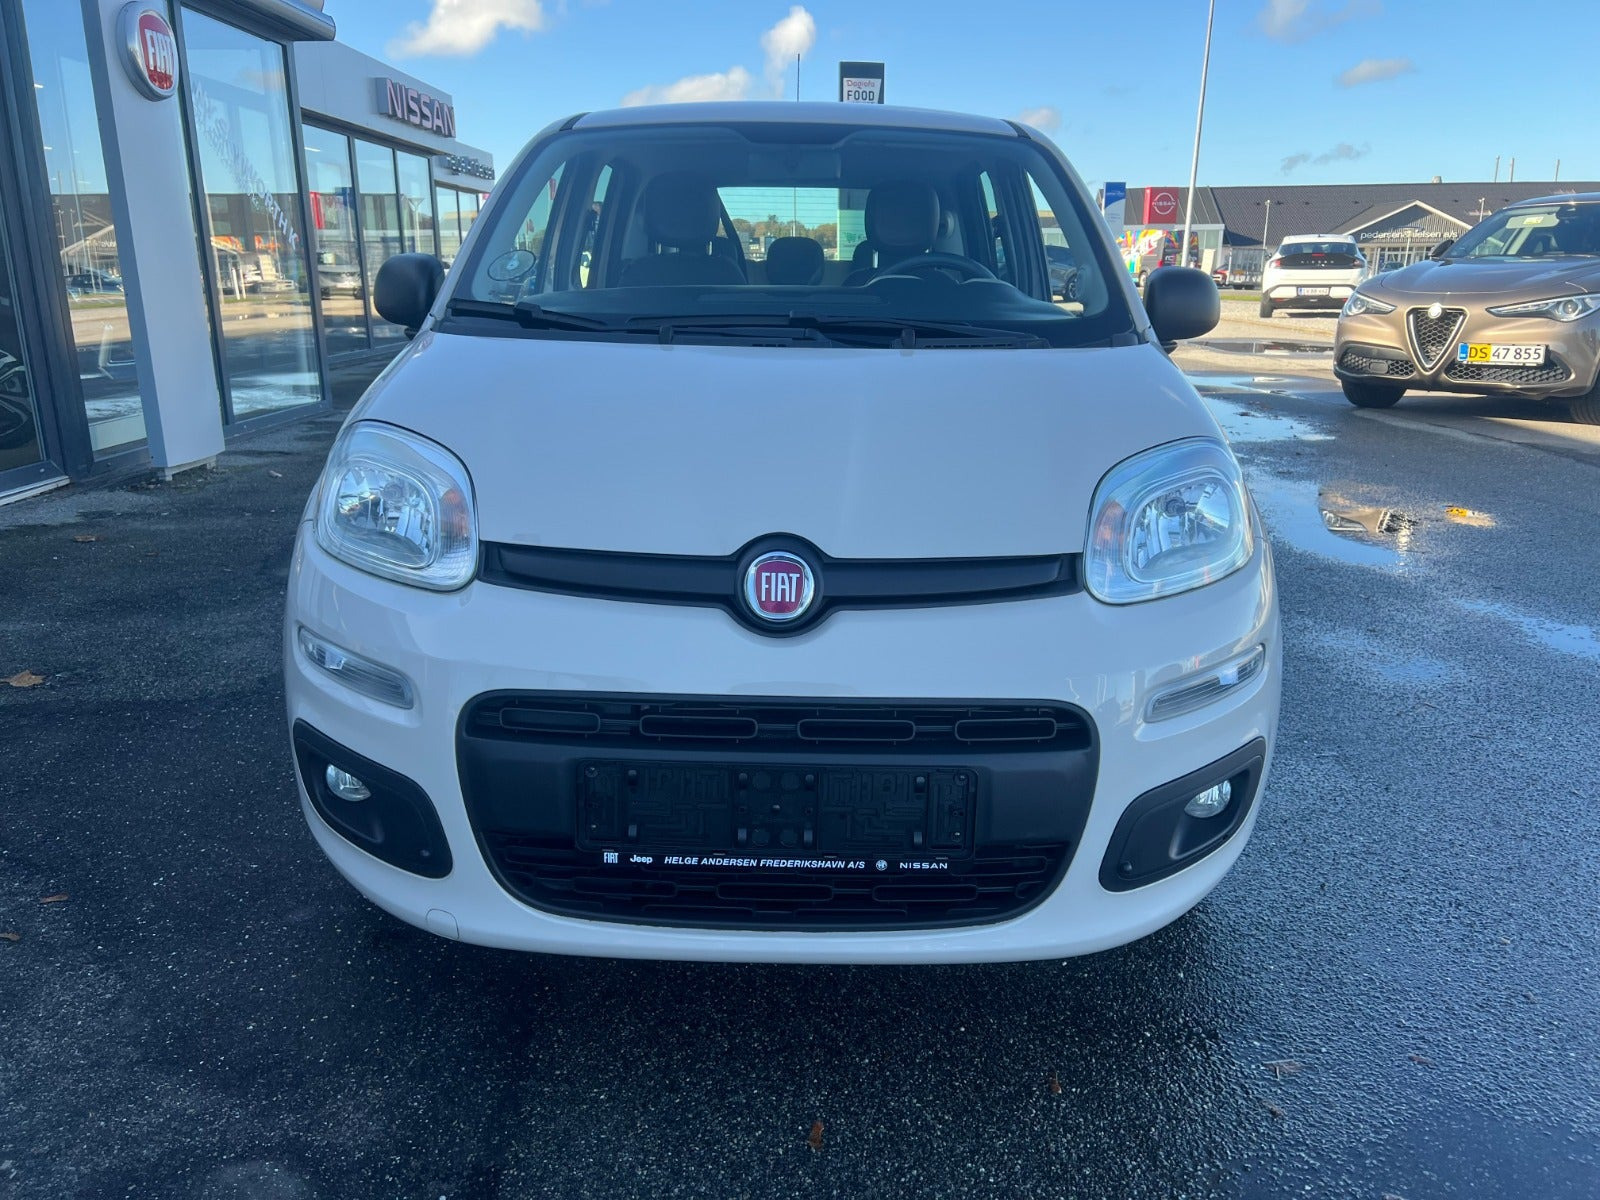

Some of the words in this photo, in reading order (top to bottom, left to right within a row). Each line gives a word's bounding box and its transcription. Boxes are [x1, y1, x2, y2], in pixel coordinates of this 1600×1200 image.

[144, 28, 174, 76] FIAT
[847, 90, 875, 101] FOOD
[386, 78, 456, 138] NISSAN
[1469, 347, 1488, 359] DS
[1492, 347, 1510, 360] 47
[1513, 347, 1541, 361] 855
[761, 572, 800, 602] FIAT
[603, 852, 618, 864] FIAT
[630, 854, 653, 864] Jeep
[664, 856, 698, 865] HELGE
[701, 857, 757, 867] ANDERSEN
[760, 859, 845, 869] FREDERIKSHAVN
[847, 860, 865, 869] A/S
